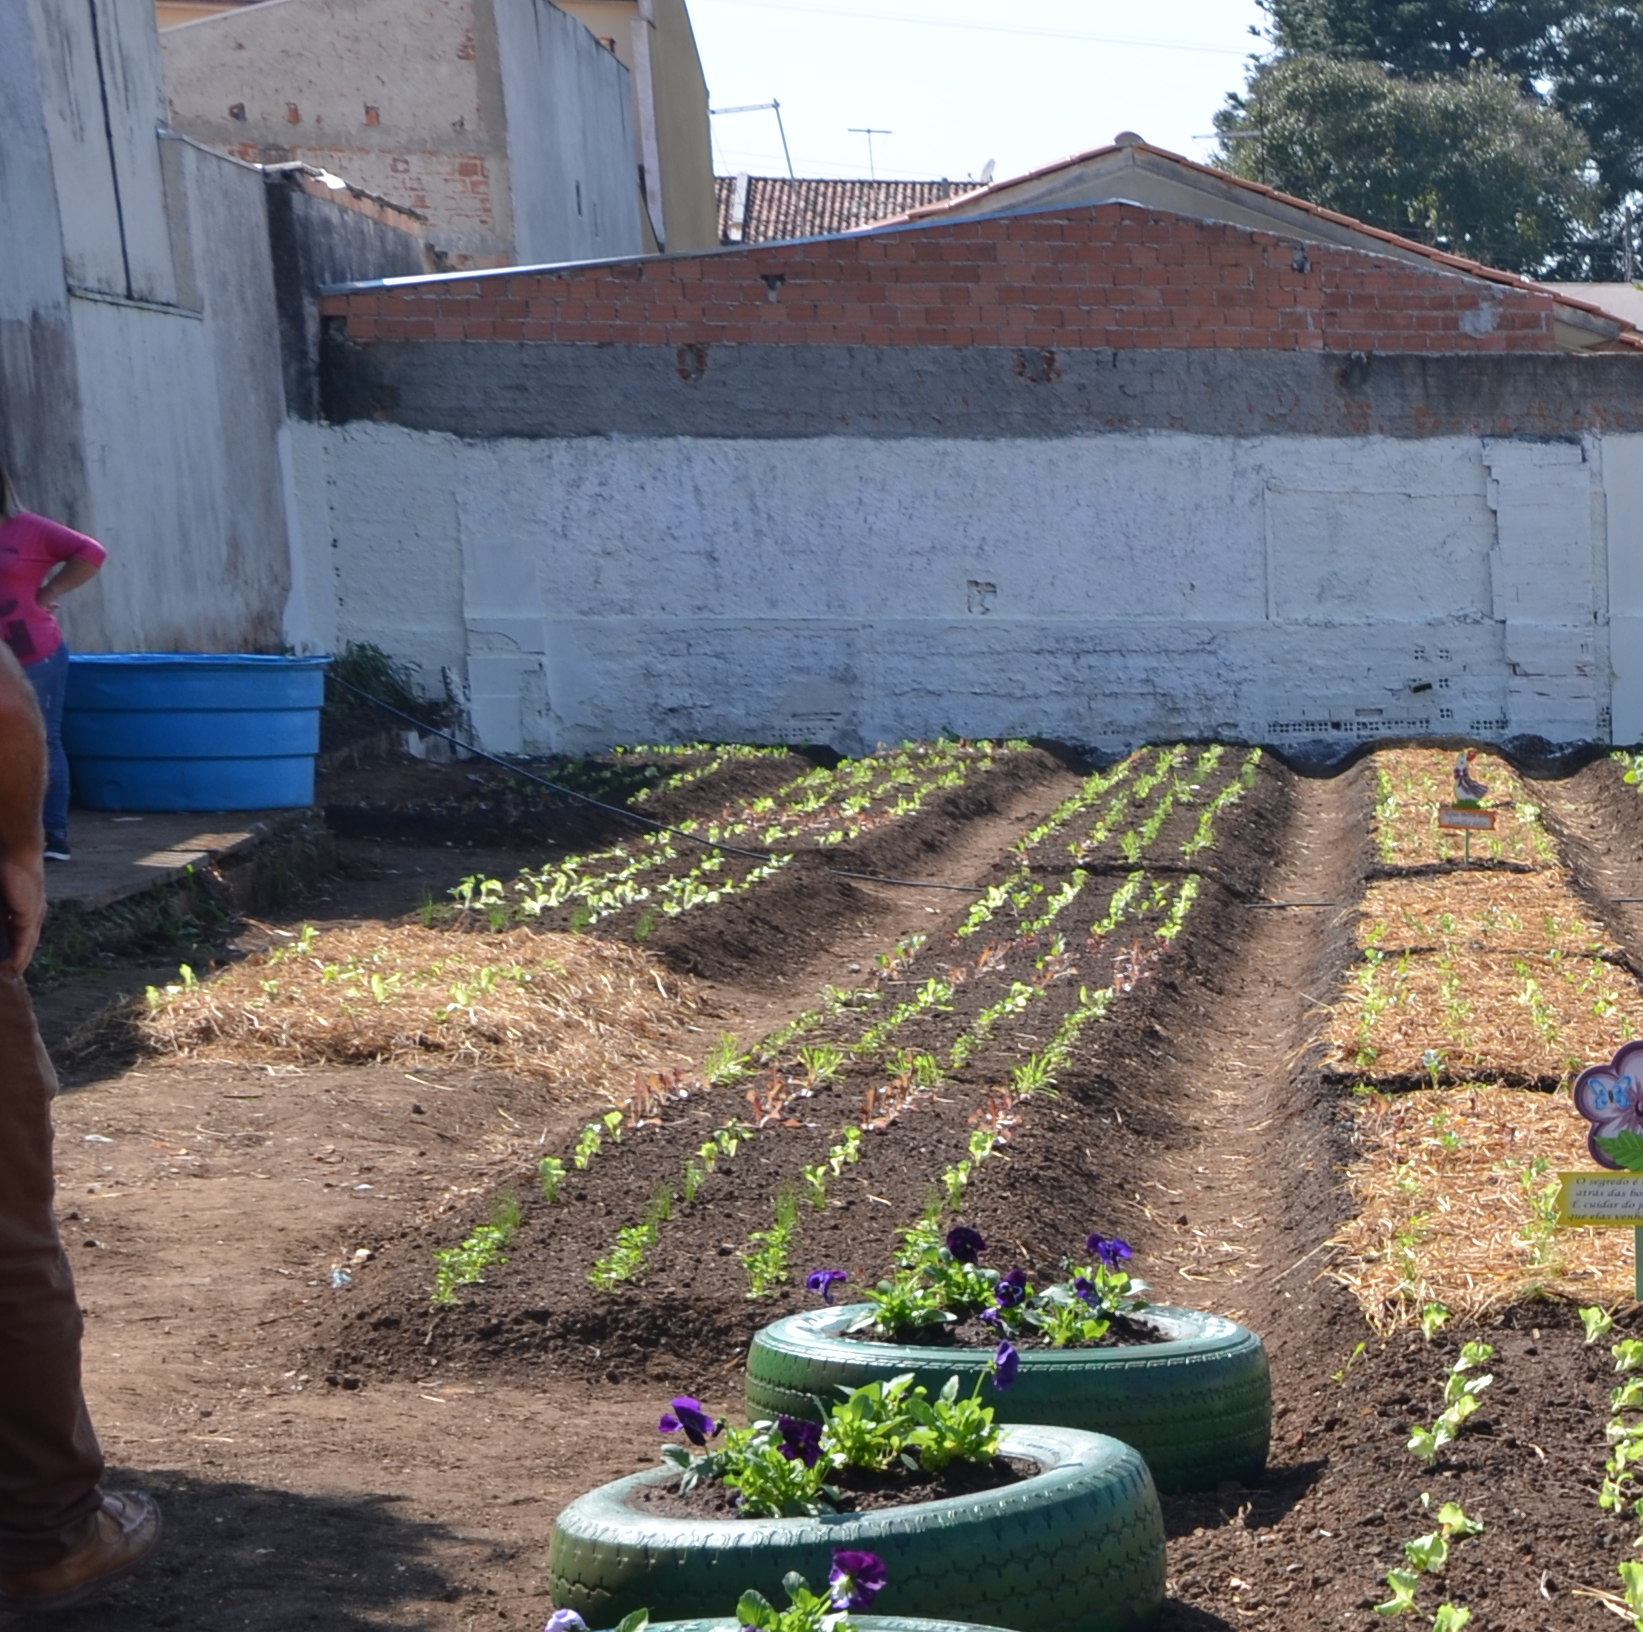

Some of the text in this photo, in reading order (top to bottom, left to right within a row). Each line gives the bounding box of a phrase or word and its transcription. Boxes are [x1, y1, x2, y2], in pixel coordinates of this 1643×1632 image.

[1590, 1177, 1629, 1187] segredo
[1575, 1189, 1604, 1197] atrás
[1607, 1189, 1626, 1197] das
[1584, 1201, 1618, 1209] cuidar
[1621, 1201, 1635, 1209] do
[1567, 1213, 1586, 1221] que
[1589, 1212, 1611, 1220] elas
